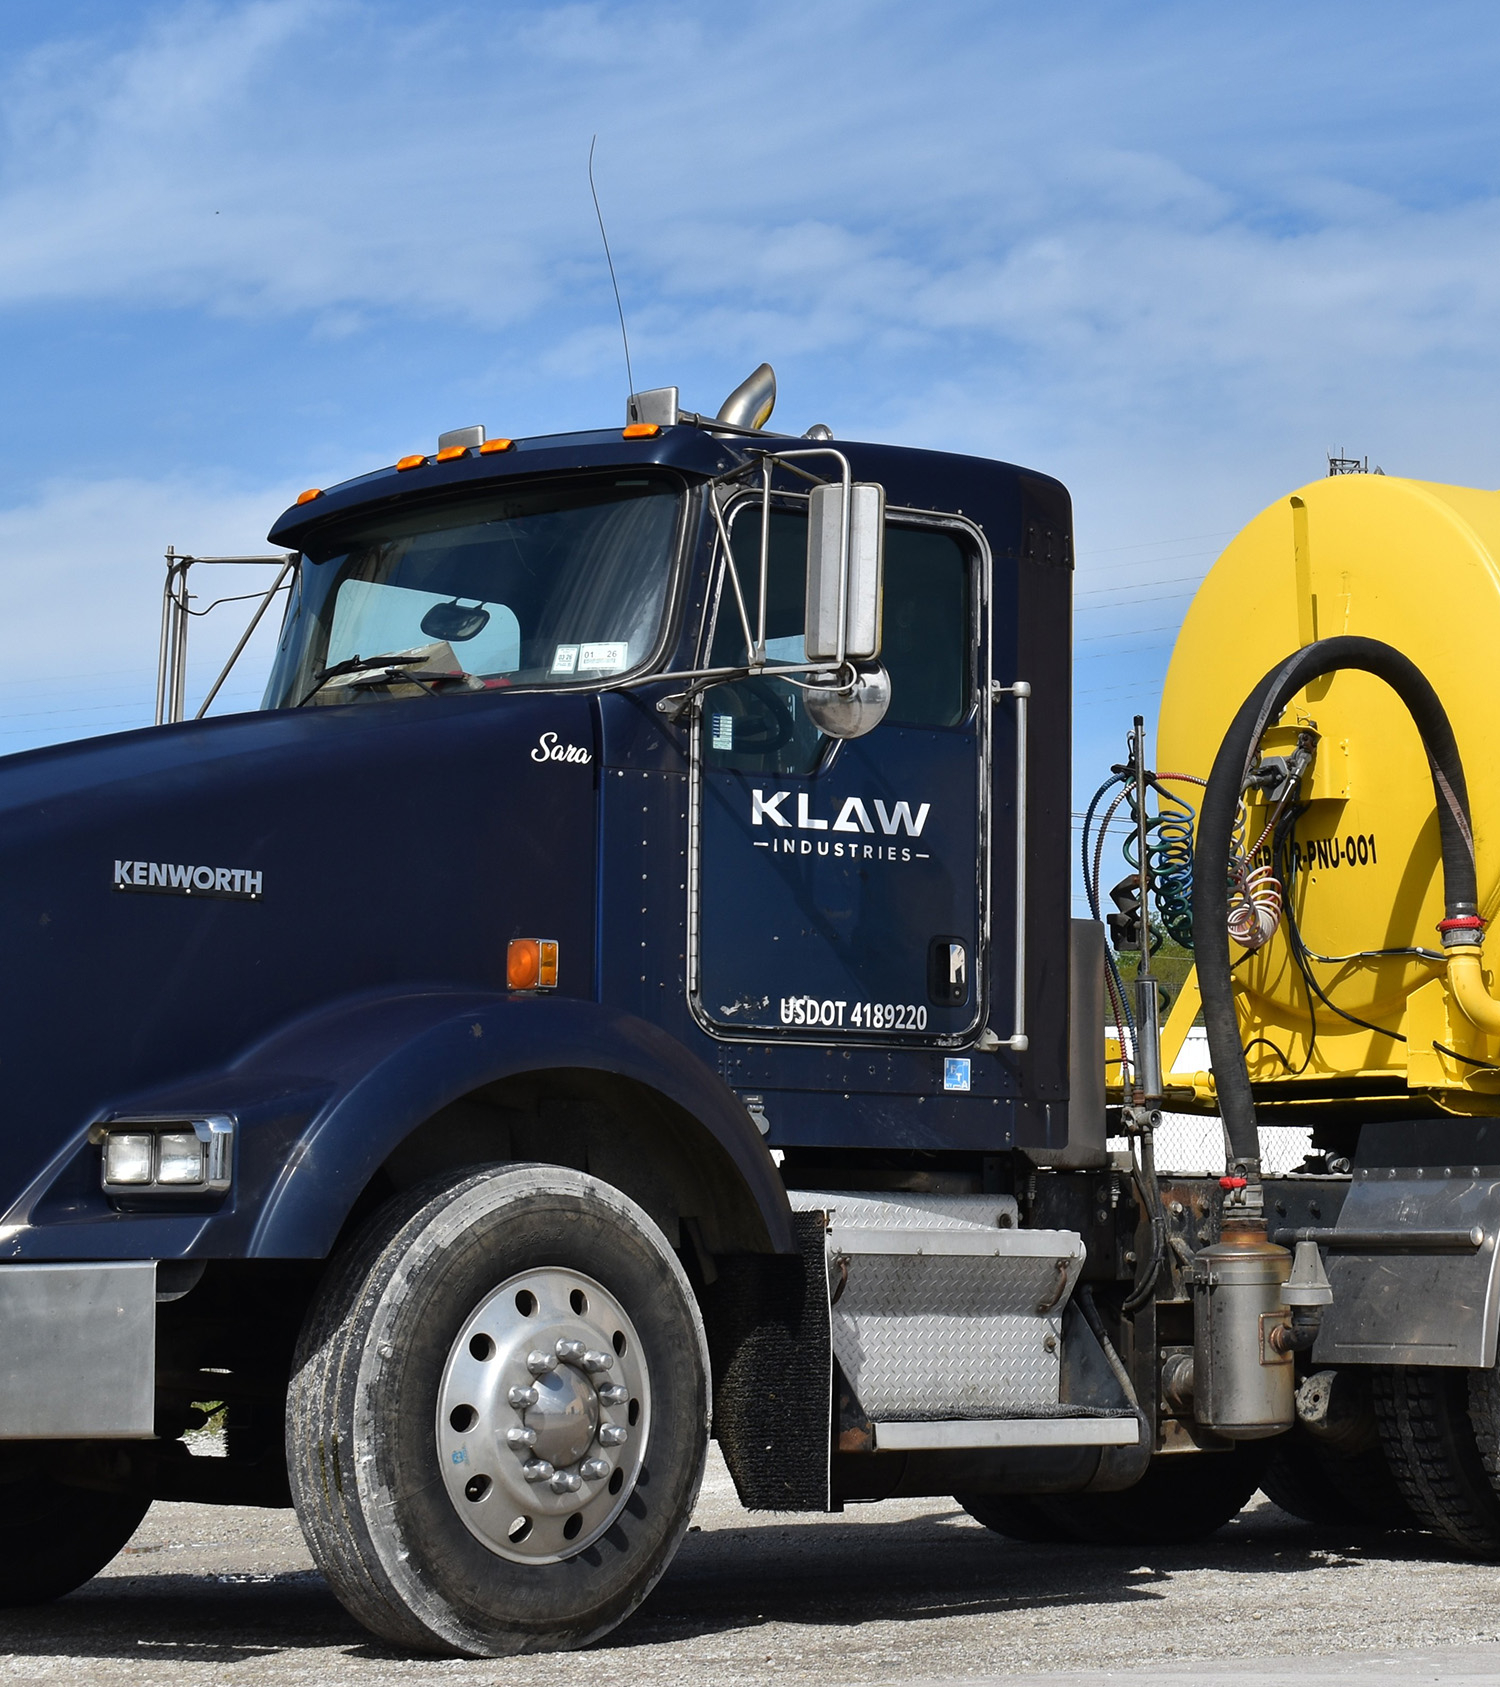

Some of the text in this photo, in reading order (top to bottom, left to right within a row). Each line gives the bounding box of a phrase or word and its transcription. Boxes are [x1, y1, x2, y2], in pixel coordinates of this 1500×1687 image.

[530, 731, 592, 765] Sara
[751, 788, 931, 837] KLAW
[773, 838, 911, 862] INDUSTRIES
[114, 860, 263, 894] KENWORTH
[780, 998, 928, 1031] USDOT 4189220
